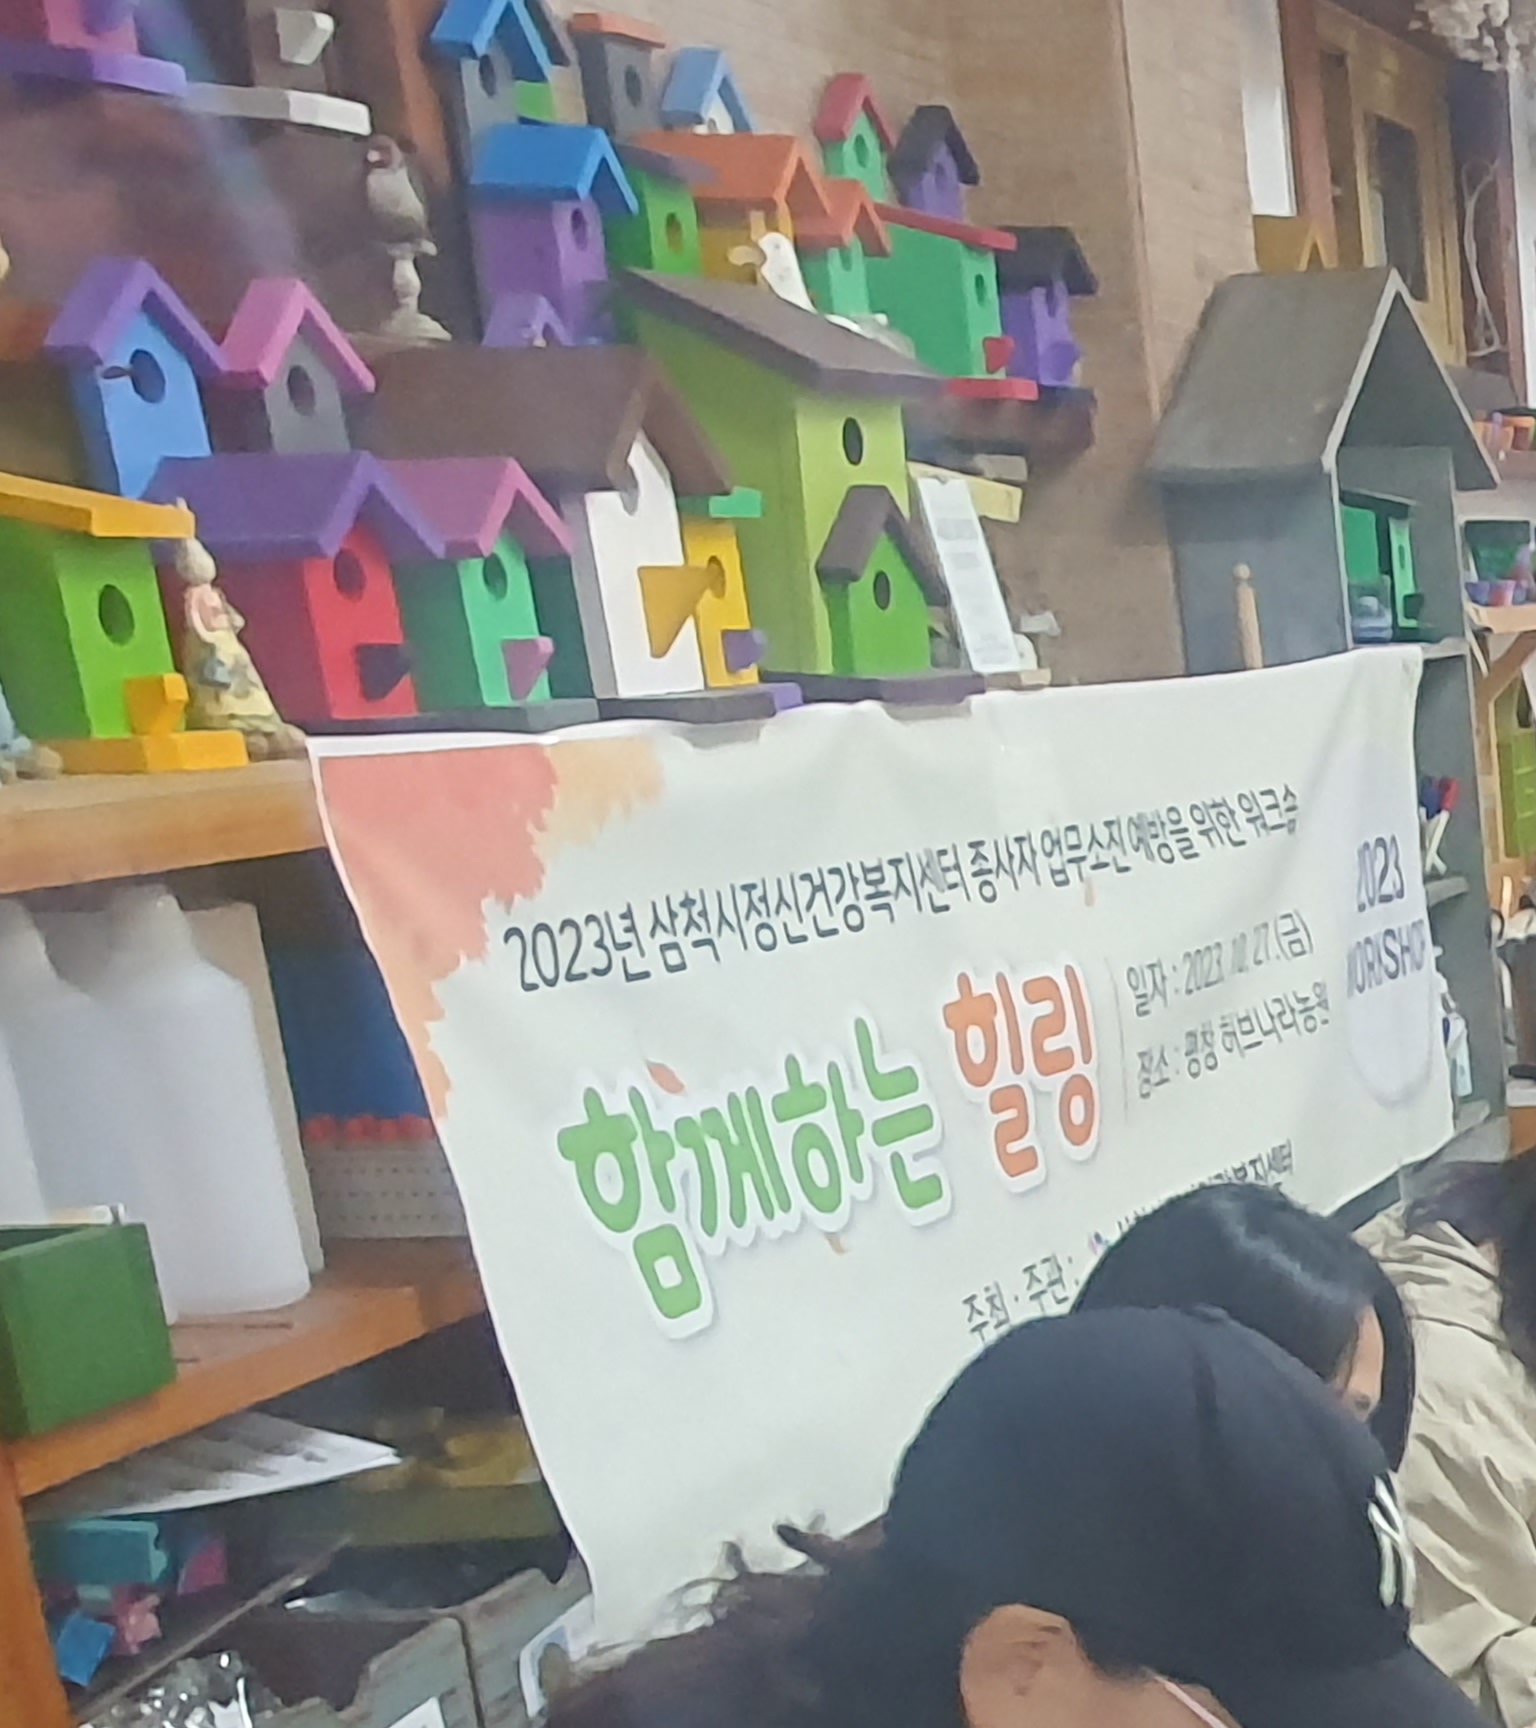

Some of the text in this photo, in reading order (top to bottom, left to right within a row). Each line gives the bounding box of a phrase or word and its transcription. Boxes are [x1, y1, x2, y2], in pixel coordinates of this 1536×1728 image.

[503, 901, 651, 992] 2023년
[649, 842, 971, 974] 삼척시정신건강복지센터
[965, 830, 1041, 904] 종사자
[1187, 797, 1244, 849] 위한
[1126, 958, 1168, 1017] 일자
[1136, 1045, 1171, 1100] 장소
[557, 964, 1096, 1321] 함께하는 힐링
[962, 1279, 1011, 1345] 주최
[1022, 1252, 1070, 1317] 주관
